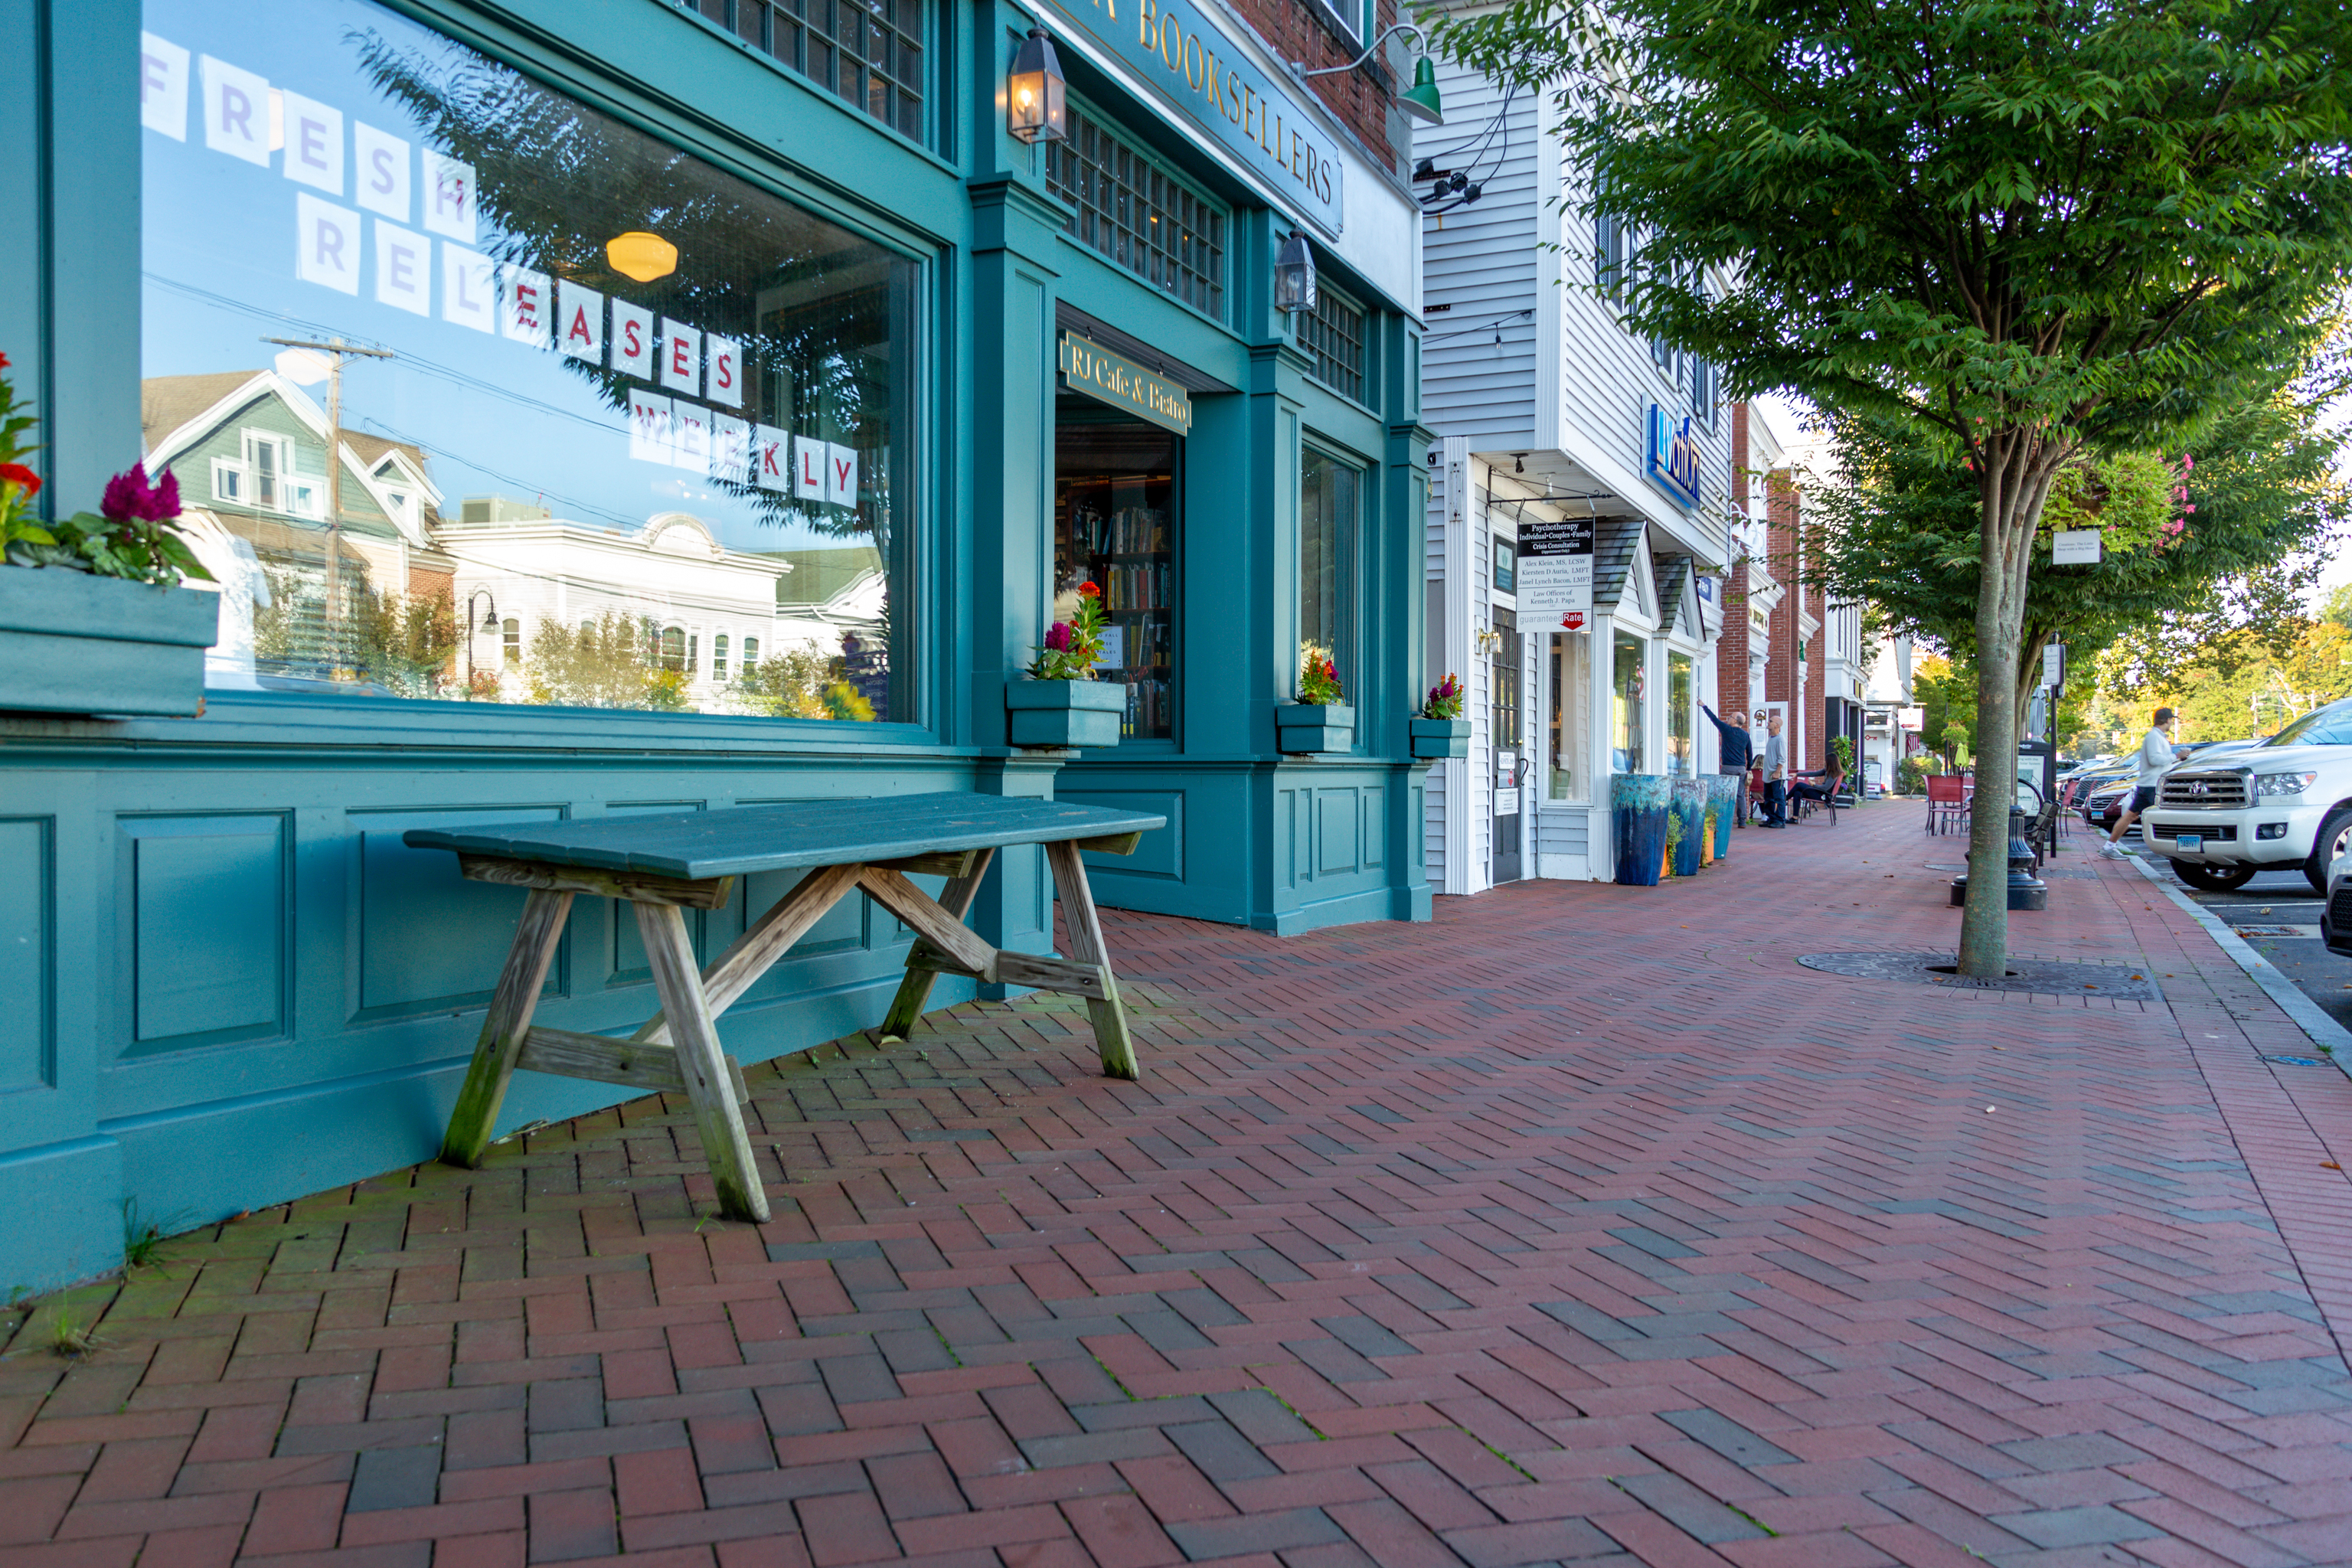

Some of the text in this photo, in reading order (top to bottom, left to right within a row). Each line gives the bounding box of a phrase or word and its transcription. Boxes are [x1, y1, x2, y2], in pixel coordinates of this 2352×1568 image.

[142, 52, 464, 223] FRESH
[1139, 0, 1331, 206] BOOKSELLERS
[316, 217, 733, 389] RELEASES
[1072, 345, 1186, 423] RJ Cafe & Bistro
[635, 404, 851, 492] WEEKLY
[1531, 523, 1579, 533] Psychotherapy
[1520, 613, 1582, 625] guaranteed Rate
